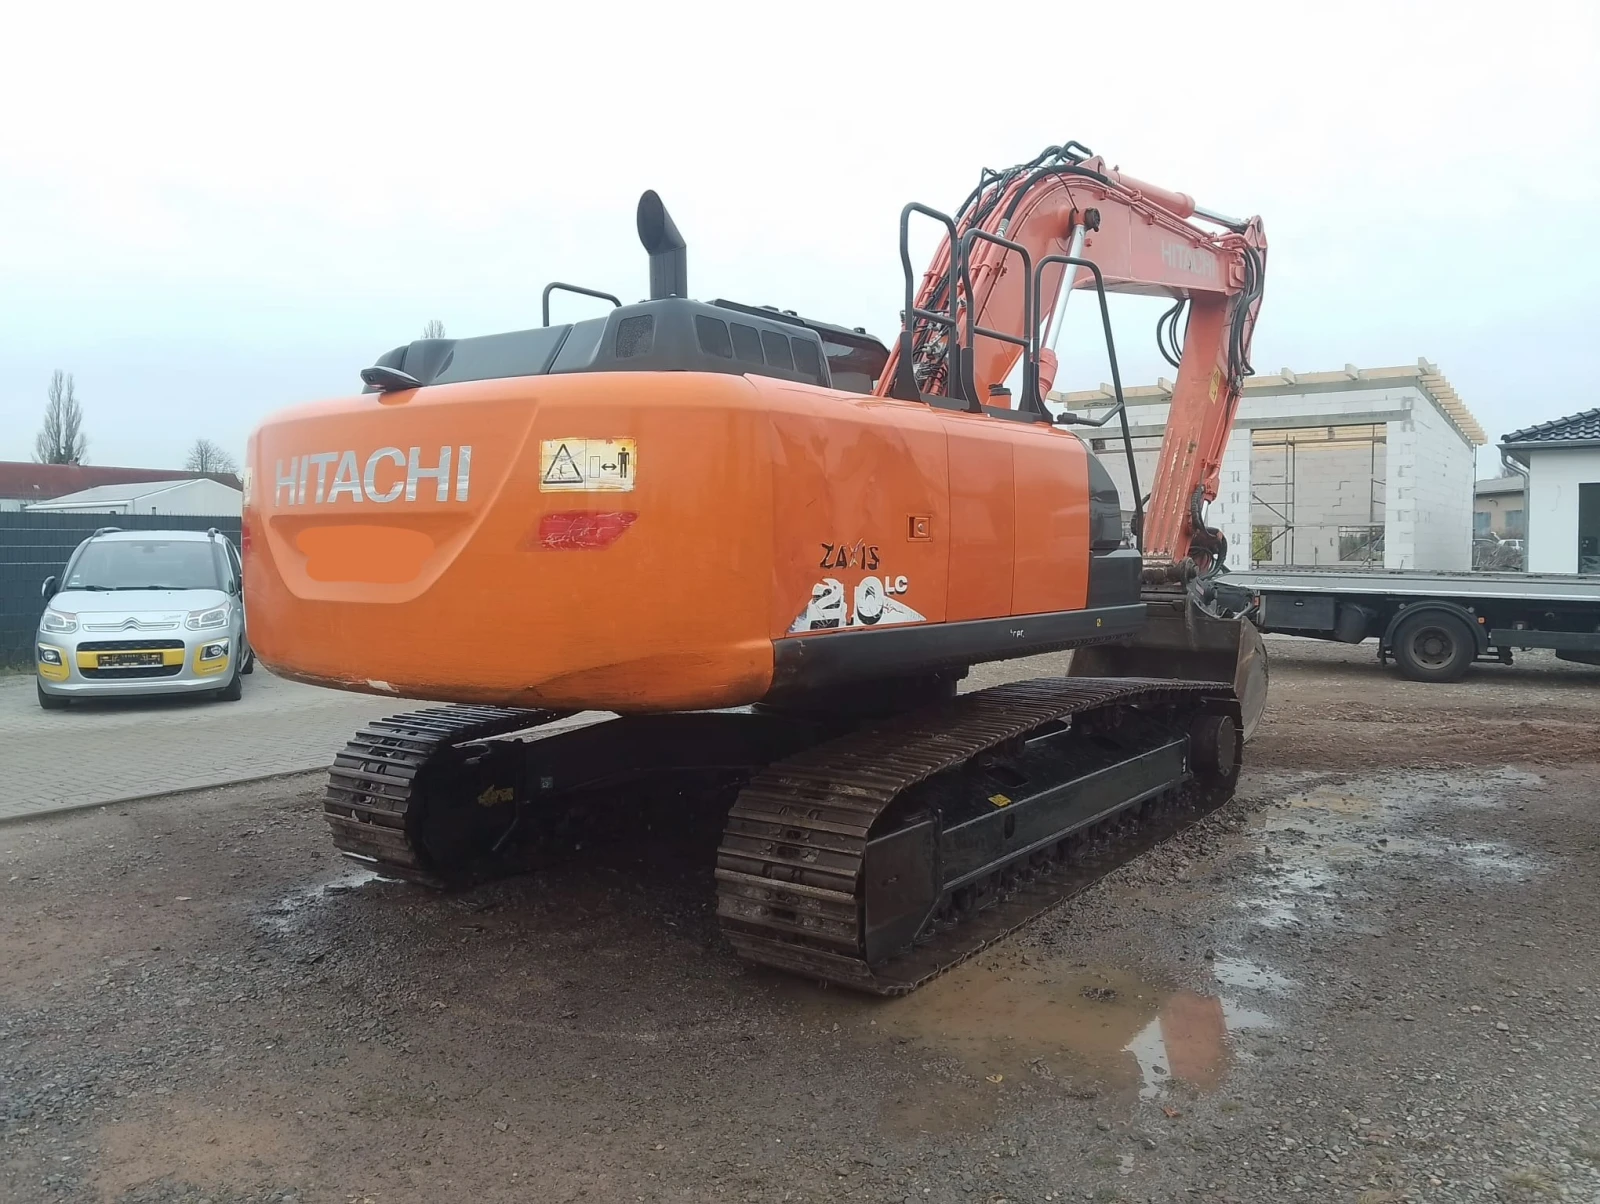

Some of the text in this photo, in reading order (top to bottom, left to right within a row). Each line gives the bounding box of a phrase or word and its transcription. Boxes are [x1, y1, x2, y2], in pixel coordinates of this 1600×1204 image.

[1161, 239, 1216, 280] HITACHI
[274, 445, 472, 507] HITACHI
[885, 575, 908, 595] LC
